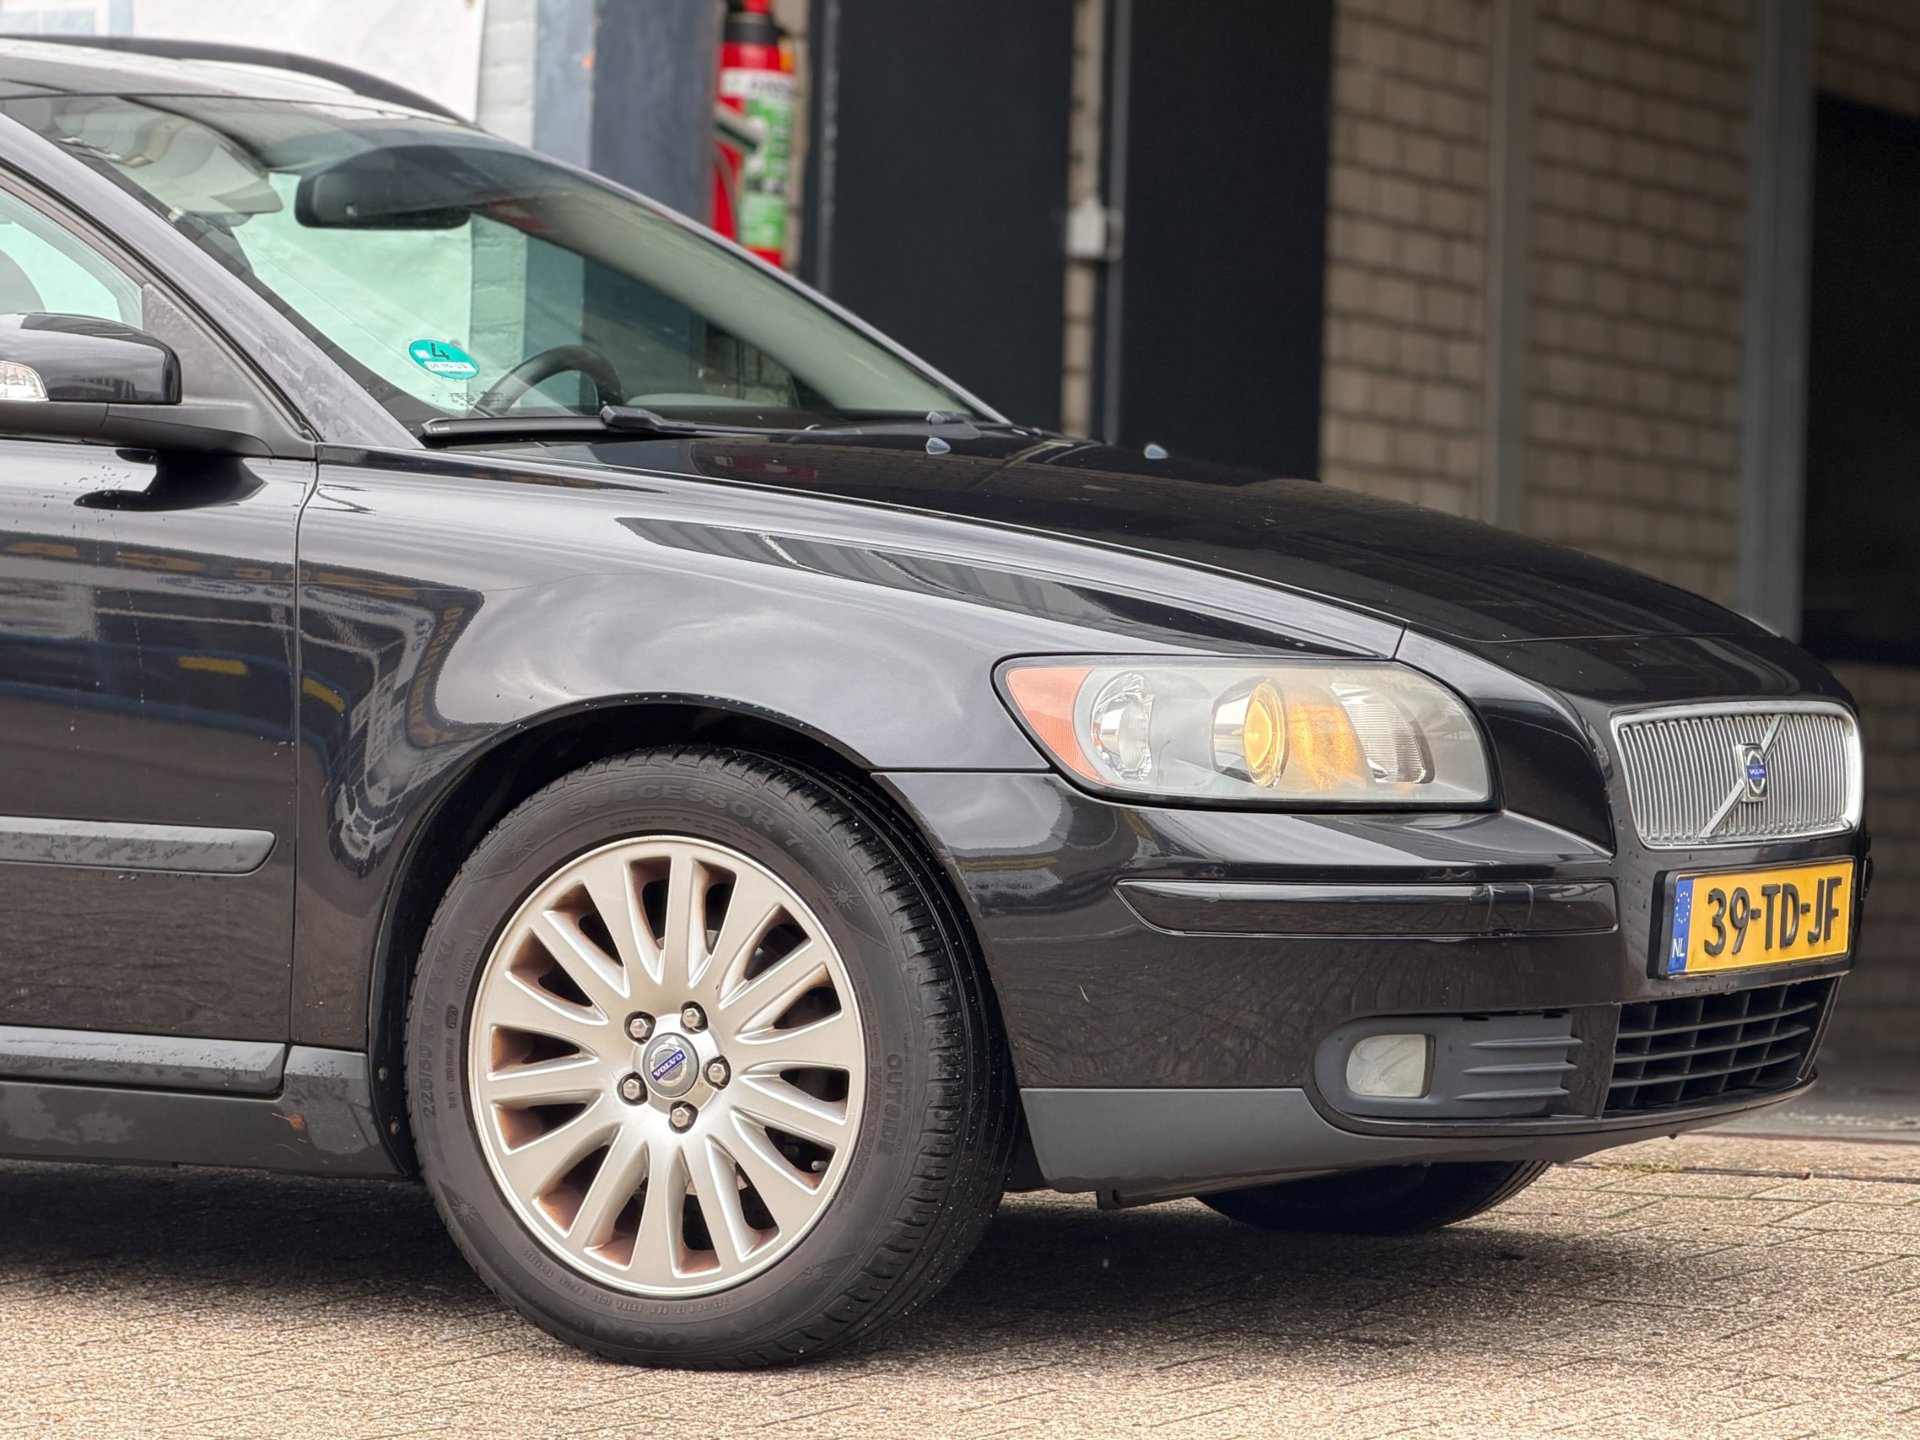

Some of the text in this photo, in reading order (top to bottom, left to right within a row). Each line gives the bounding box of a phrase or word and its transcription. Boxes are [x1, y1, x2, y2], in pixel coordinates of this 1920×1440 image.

[430, 342, 451, 360] 4
[568, 783, 777, 833] SUCCESSOR
[784, 831, 805, 848] 7
[1704, 876, 1843, 958] 39-TD-JF
[1671, 937, 1686, 959] NL
[653, 1052, 683, 1077] VOLVO
[878, 1052, 904, 1156] OUTSIDE
